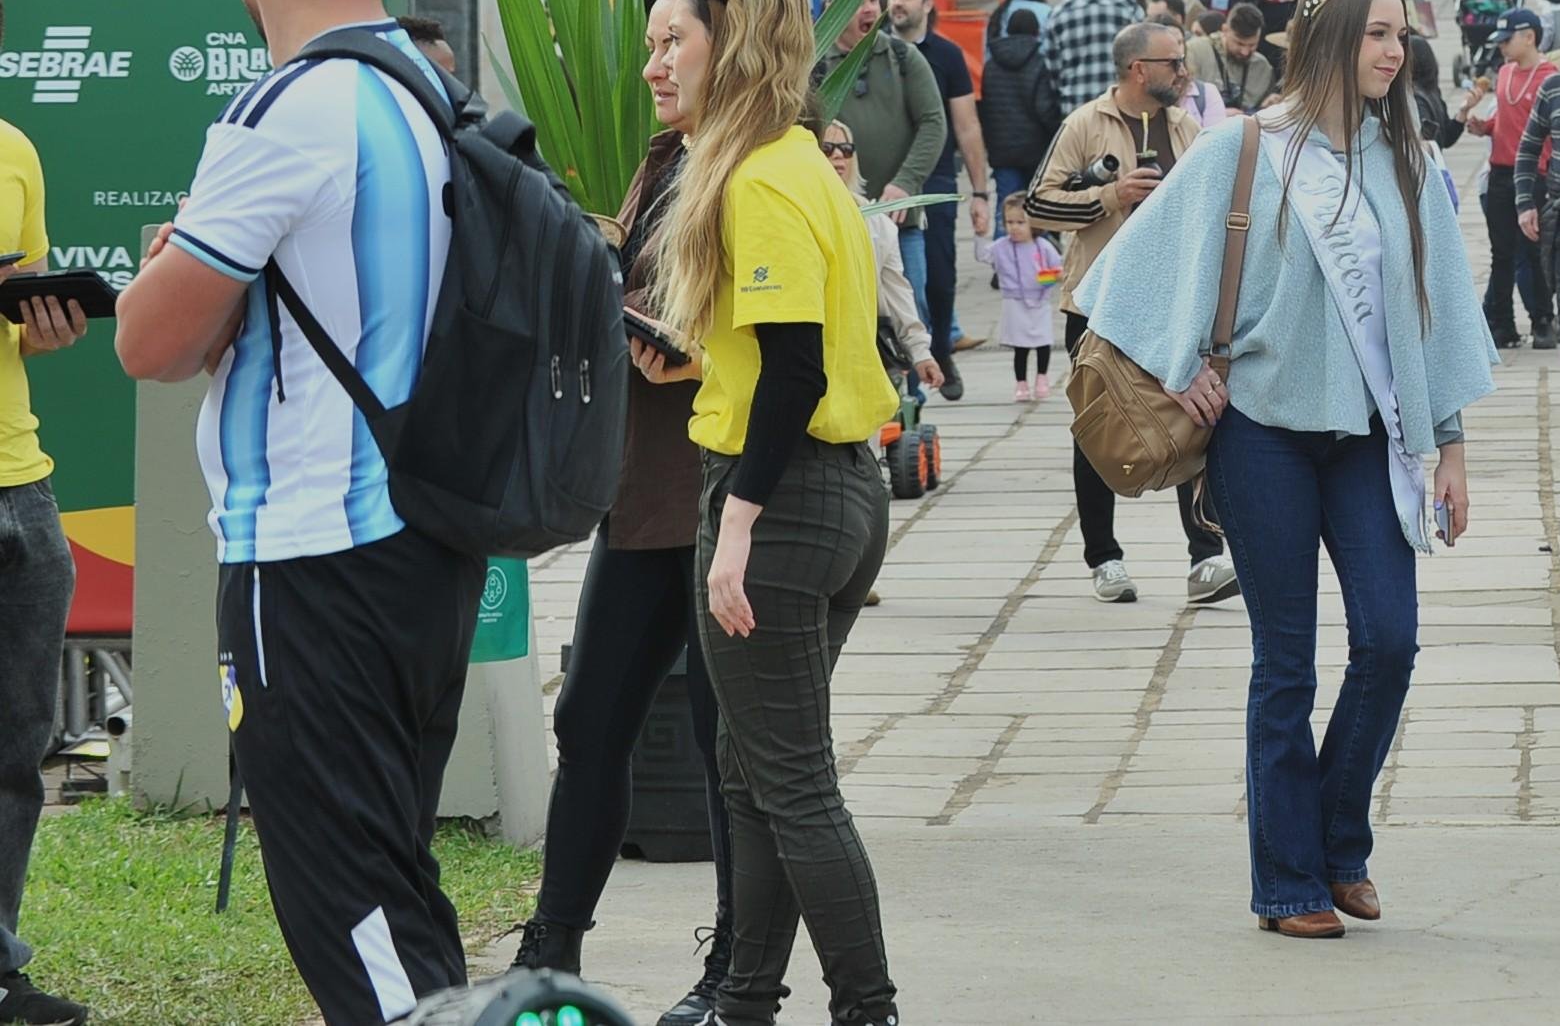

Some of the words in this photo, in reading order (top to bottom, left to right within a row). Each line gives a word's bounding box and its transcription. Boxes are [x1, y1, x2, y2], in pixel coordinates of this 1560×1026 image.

[205, 32, 247, 46] CNA
[0, 51, 133, 78] SEBRAE
[206, 82, 253, 95] ART
[51, 246, 134, 268] VIVA
[96, 270, 133, 291] S
